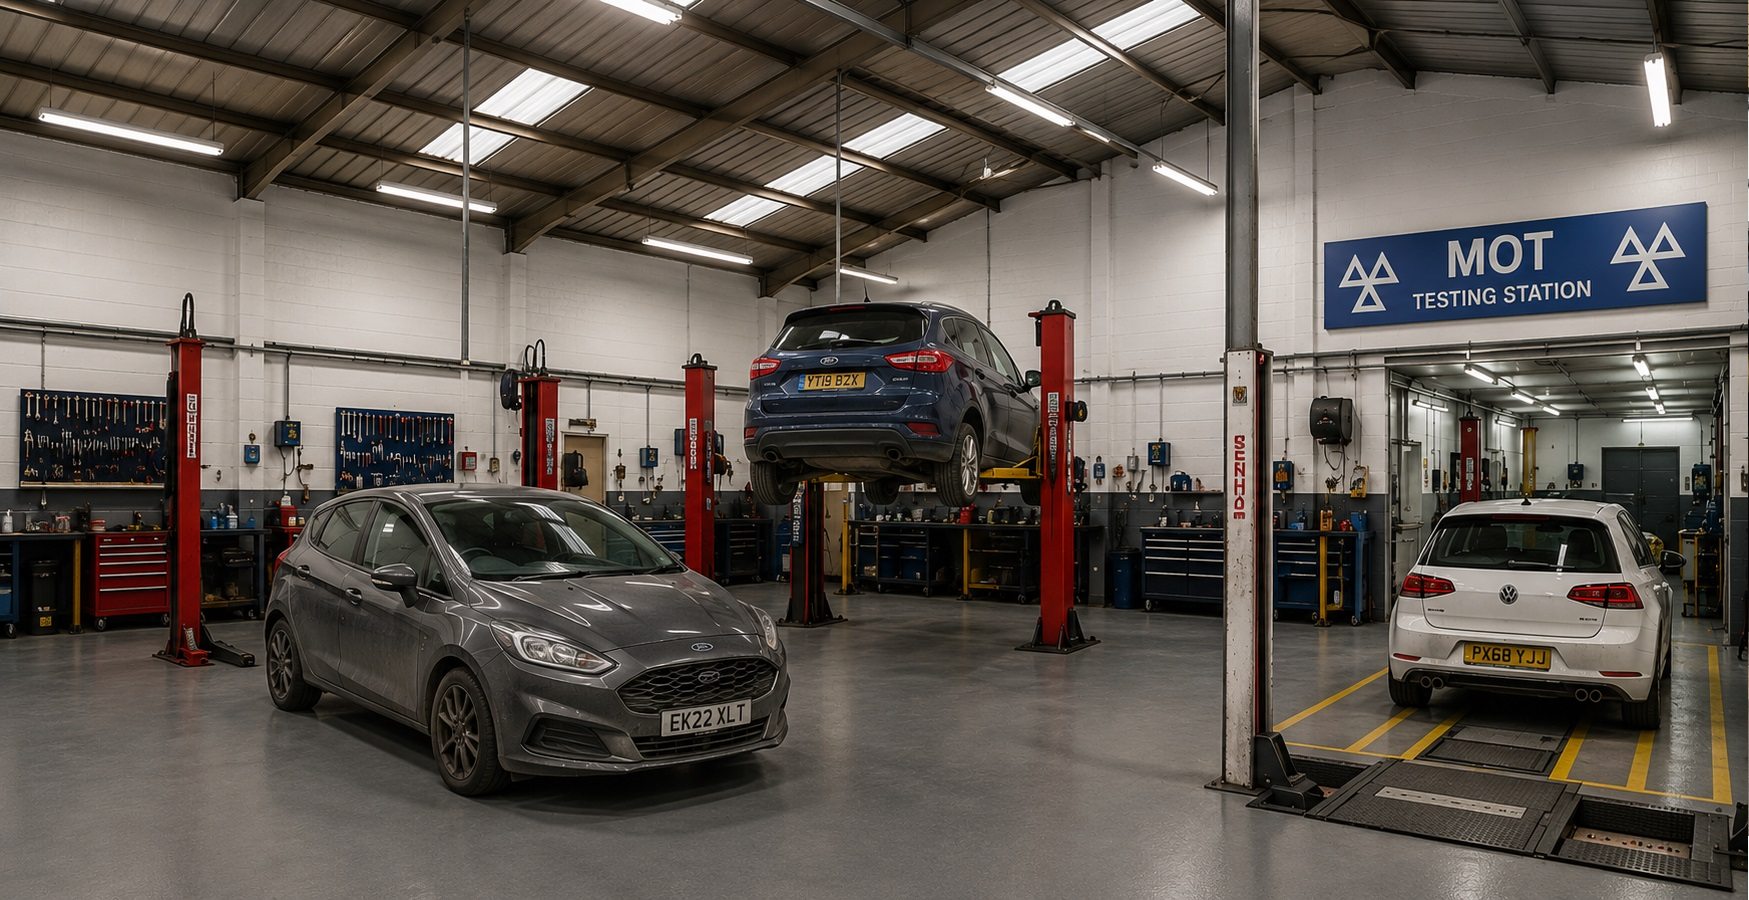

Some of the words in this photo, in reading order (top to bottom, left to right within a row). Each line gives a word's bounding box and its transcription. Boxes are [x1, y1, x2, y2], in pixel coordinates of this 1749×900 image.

[1447, 230, 1554, 278] MOT
[1412, 286, 1497, 310] TESTING
[1503, 279, 1592, 305] STATION
[807, 374, 832, 388] YT19
[835, 373, 860, 387] BZX
[1471, 645, 1512, 663] PX68
[1516, 648, 1546, 665] YJJ
[669, 709, 713, 732] EK22
[716, 703, 746, 726] XLT
